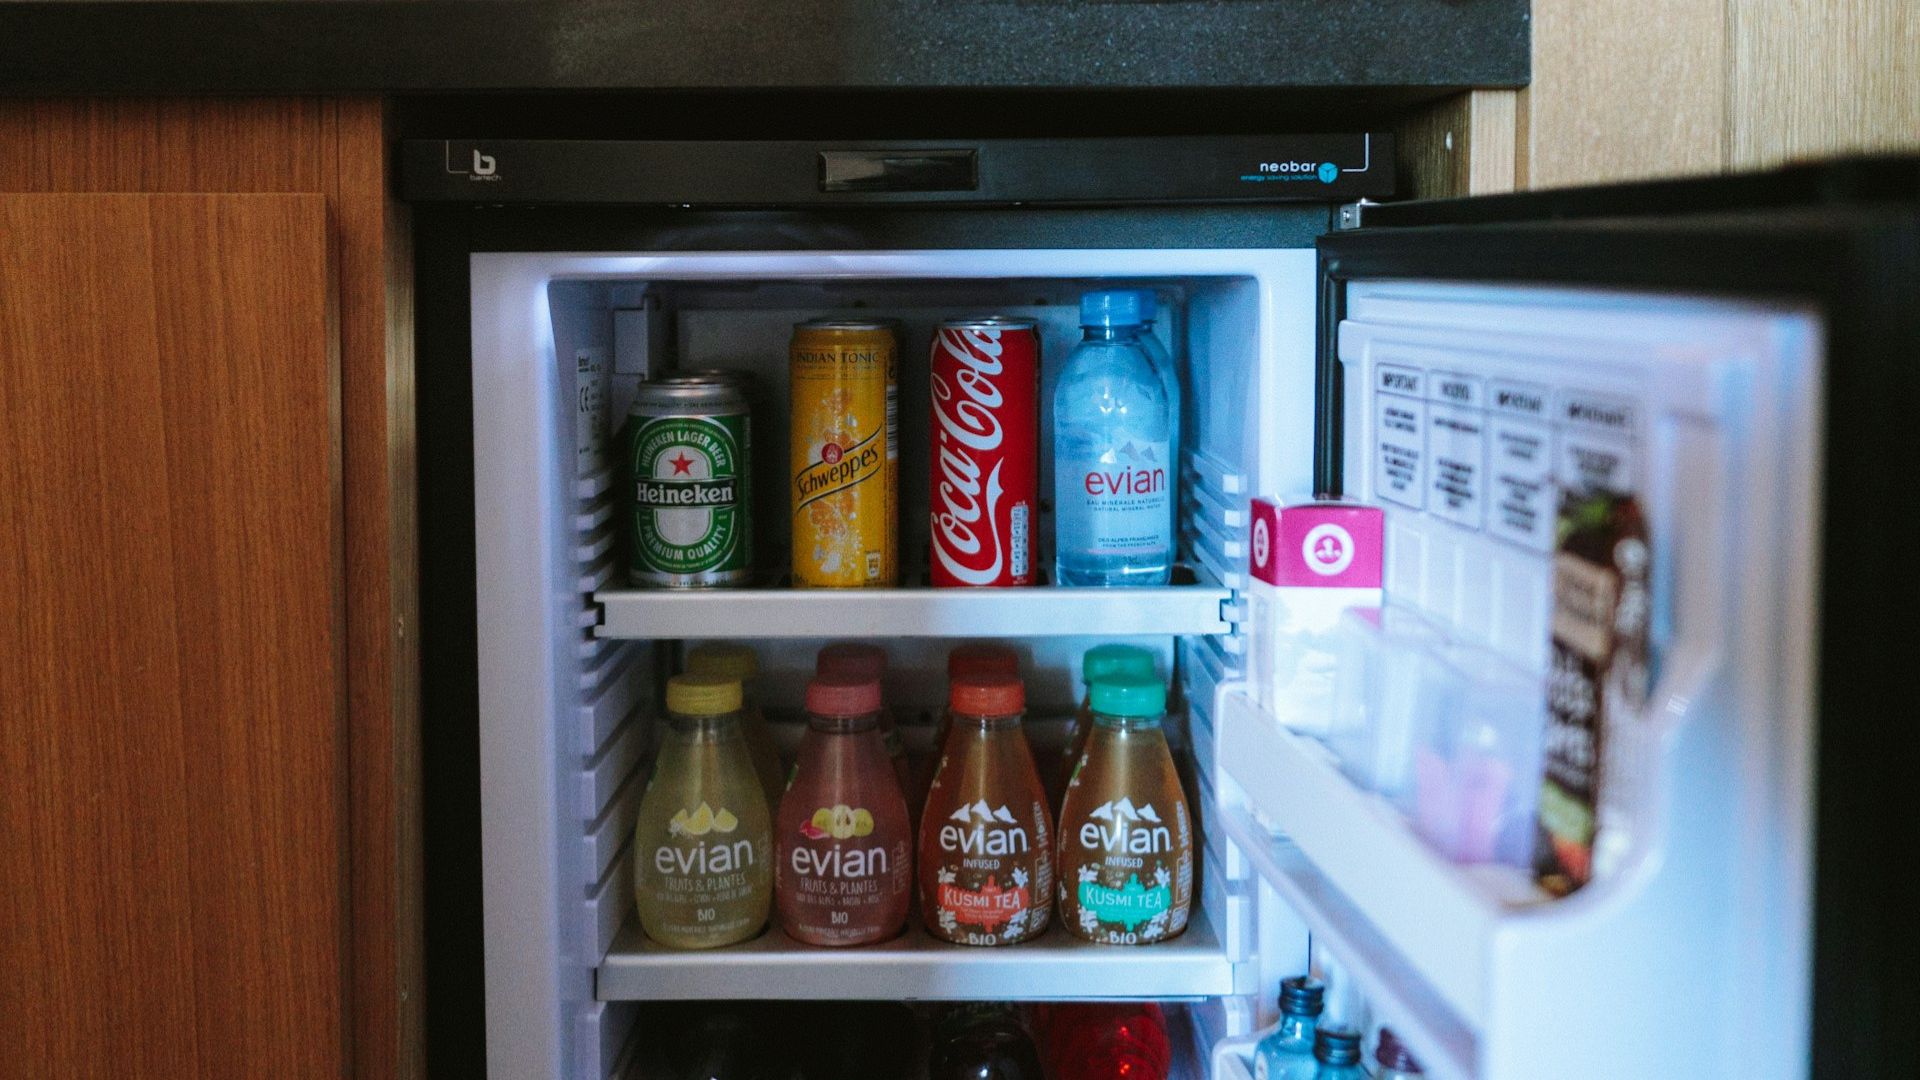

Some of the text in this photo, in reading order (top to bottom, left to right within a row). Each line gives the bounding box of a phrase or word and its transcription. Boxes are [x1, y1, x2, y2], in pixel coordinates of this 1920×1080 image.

[1260, 160, 1316, 173] neobar
[1240, 174, 1265, 182] energy
[841, 351, 880, 363] TONIC
[641, 430, 727, 468] HEINEKEN LAGER BEER
[797, 443, 878, 501] Schweppes
[1085, 465, 1165, 496] evian
[636, 482, 734, 505] Heineken
[643, 524, 726, 561] PREMIUM QUALITY
[940, 824, 1028, 855] evian
[1080, 822, 1171, 853] evian
[655, 840, 753, 875] evian
[791, 844, 887, 878] evian
[963, 859, 1001, 870] INFUSED
[1105, 856, 1144, 868] INFUSED
[665, 872, 746, 892] FRUITS & PLANTES
[800, 878, 878, 895] FRUITS & PLANTES
[943, 887, 1020, 909] KUSMI TEA
[1085, 886, 1162, 909] KUSMI TEA
[697, 907, 716, 921] BIO
[831, 911, 849, 925] BIO
[968, 932, 997, 945] BIO
[1109, 930, 1137, 944] BIO
